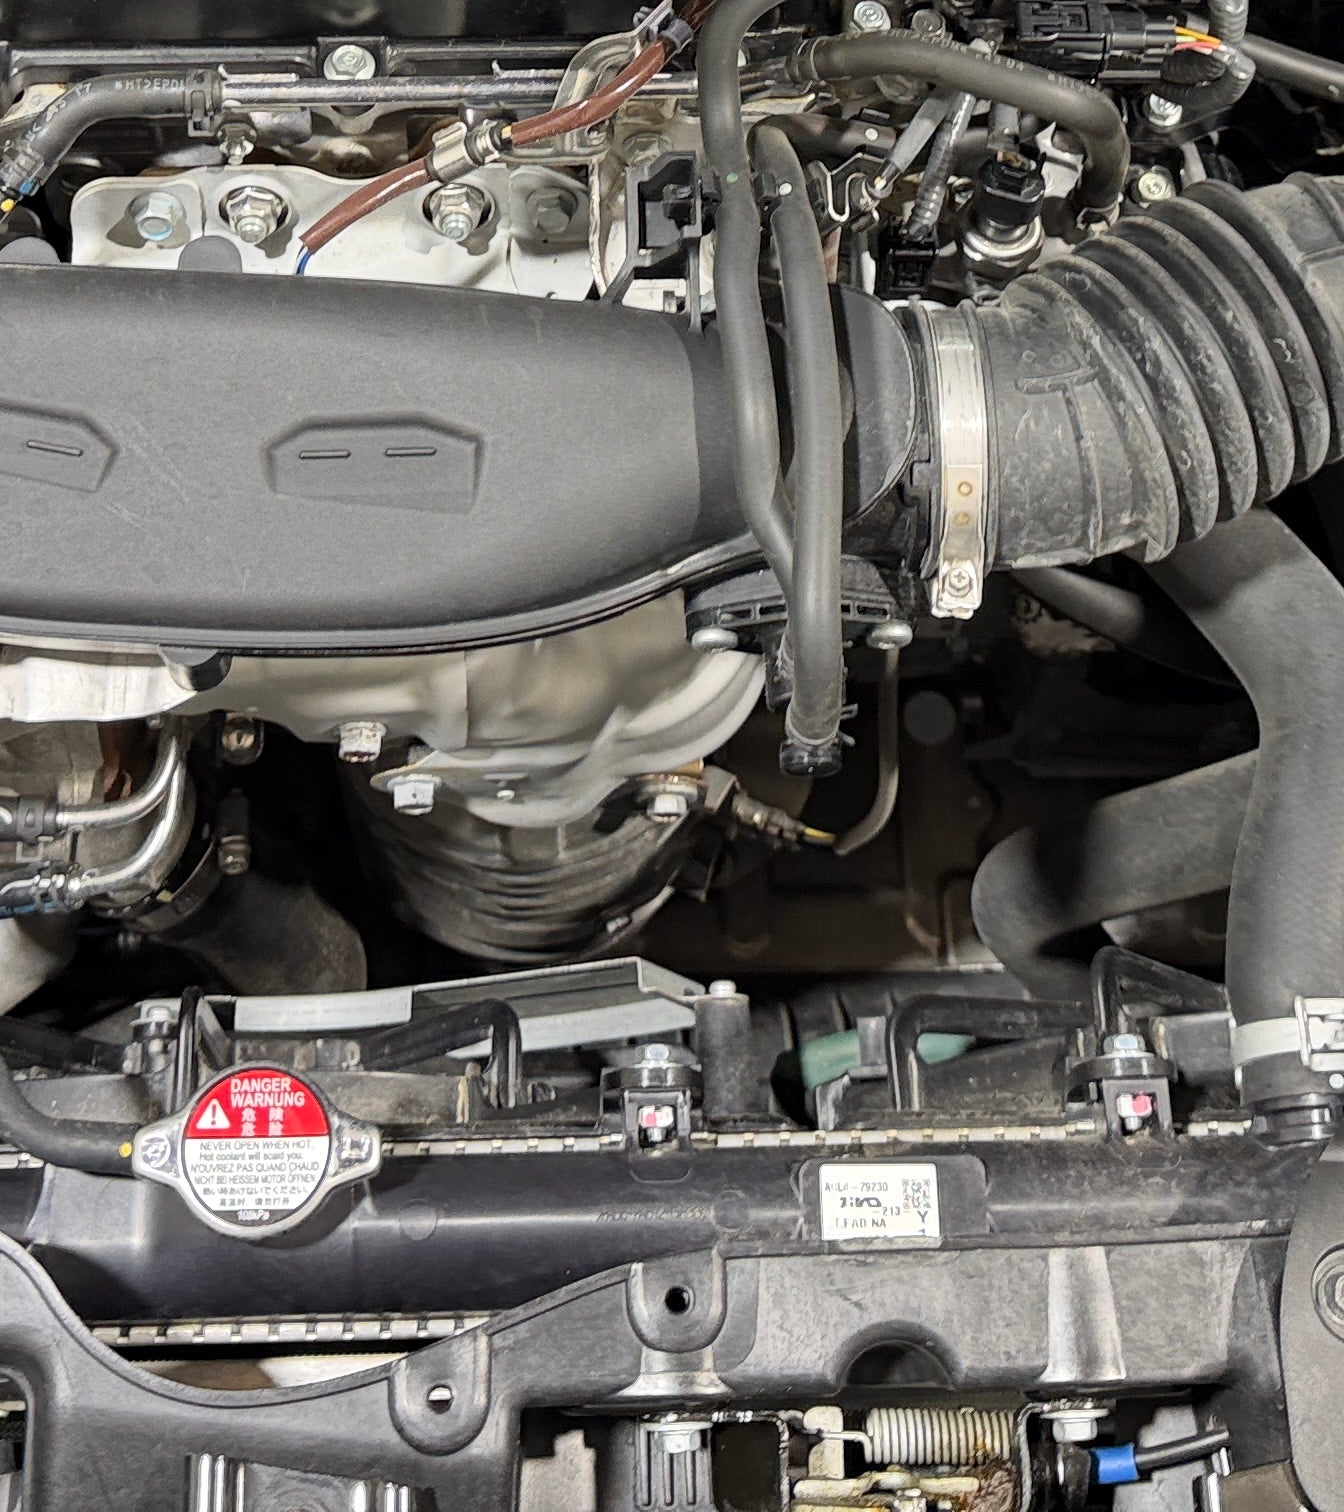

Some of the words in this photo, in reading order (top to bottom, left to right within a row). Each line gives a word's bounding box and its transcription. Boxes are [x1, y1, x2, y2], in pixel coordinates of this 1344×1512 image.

[230, 1078, 291, 1092] DANGER
[230, 1092, 305, 1107] WARNUNG
[200, 1141, 231, 1150] NEVER
[234, 1141, 259, 1150] OPEN
[262, 1140, 289, 1149] WHEN
[200, 1152, 213, 1160] Hot
[216, 1152, 245, 1160] coolant
[248, 1152, 260, 1160] will
[191, 1164, 233, 1173] N'OUVREZ
[236, 1163, 253, 1172] PAS
[256, 1163, 286, 1173] QUAND
[289, 1162, 319, 1171] CHAUD
[262, 1175, 285, 1184] MOTOR
